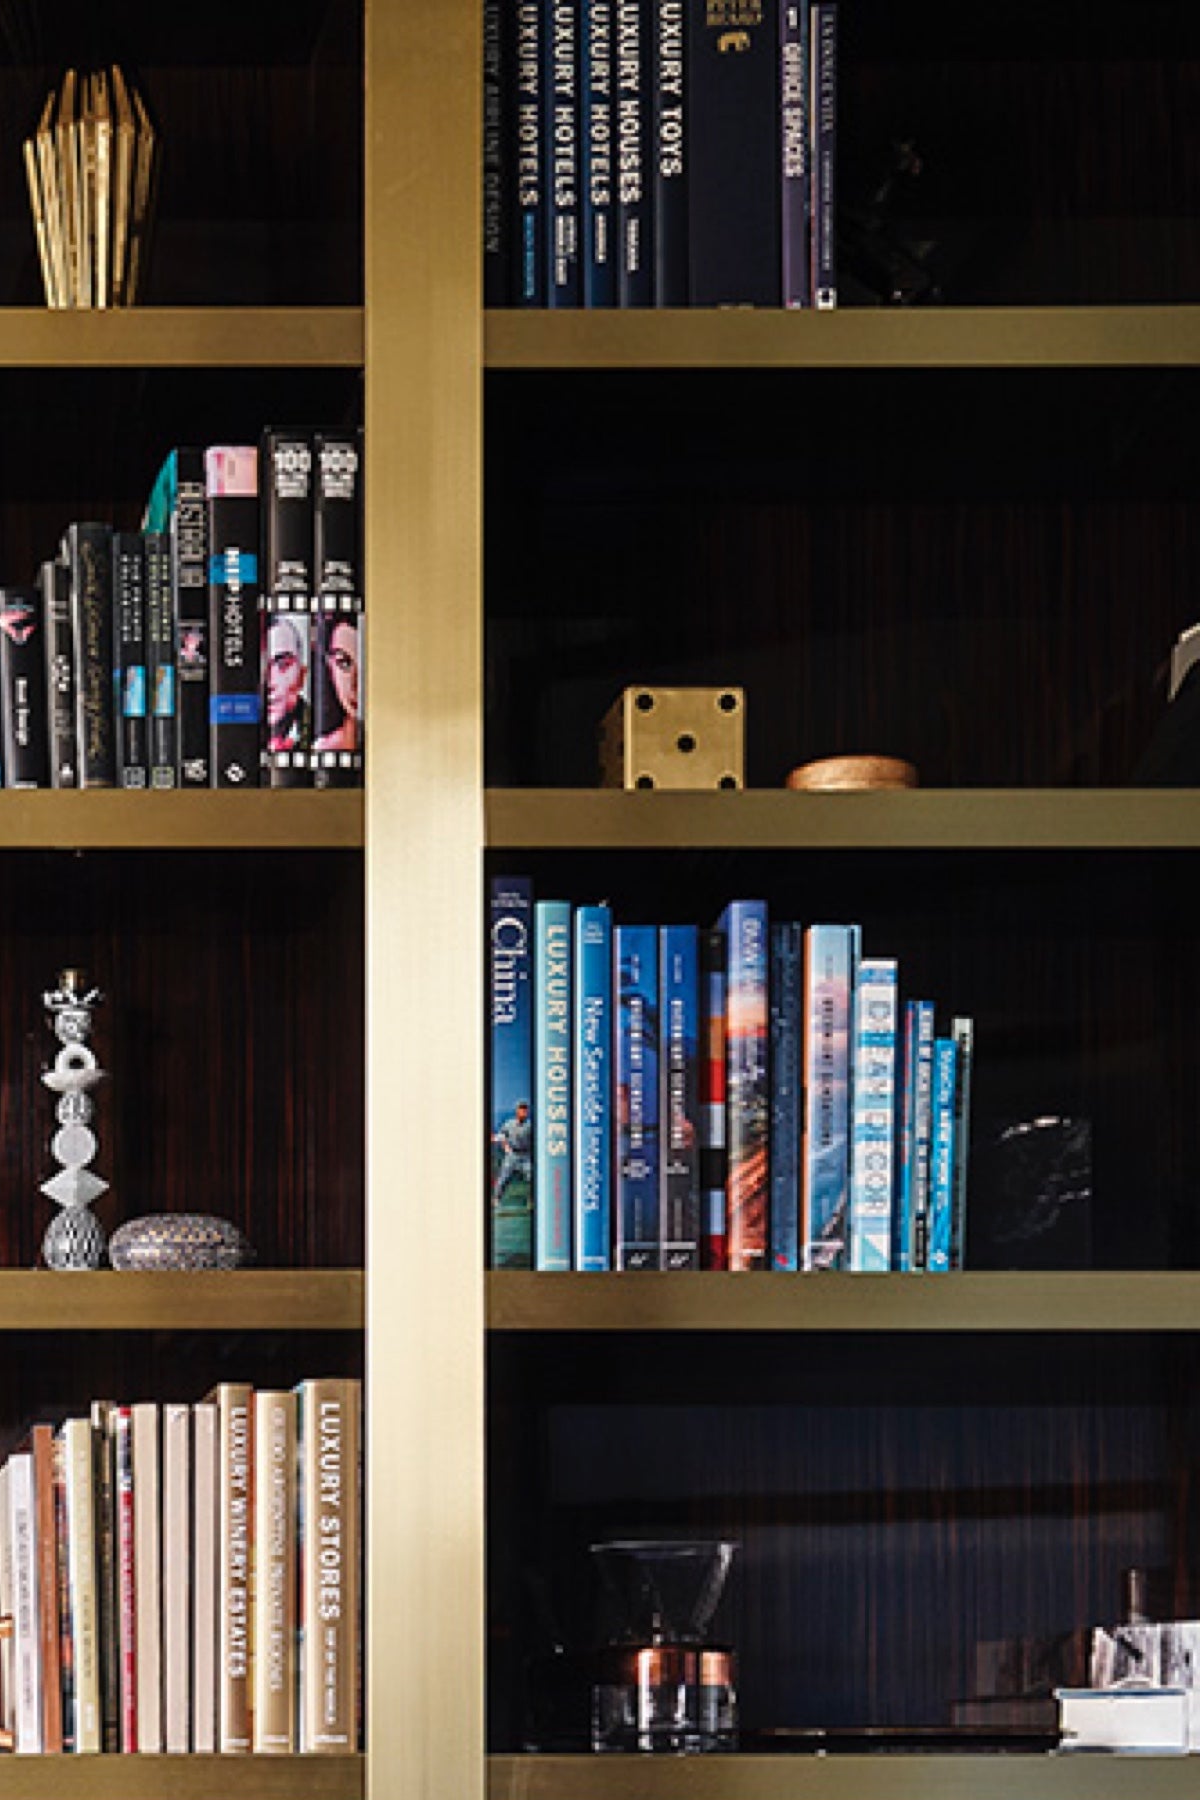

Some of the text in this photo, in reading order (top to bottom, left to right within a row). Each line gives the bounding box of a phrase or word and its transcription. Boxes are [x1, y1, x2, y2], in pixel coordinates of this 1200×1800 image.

[590, 0, 611, 96] UXURY
[619, 0, 641, 92] UXURY
[659, 1, 683, 178] UXURY TOYS
[519, 0, 539, 207] UXURY HOTELS
[554, 0, 576, 208] UXURY HOTELS
[590, 102, 611, 207] HOTELS
[619, 100, 641, 206] HOUSES
[178, 481, 204, 588] AUSTRALIA
[491, 916, 528, 1025] China
[546, 925, 567, 1035] LUXURY
[546, 1046, 567, 1157] HOUSES
[583, 997, 602, 1212] New Seaside Interiors
[864, 1000, 890, 1215] DREAM DECOR
[319, 1401, 340, 1506] LUXURY
[229, 1406, 247, 1678] LUXURY WINERY ESTATES
[319, 1516, 340, 1620] STORES
